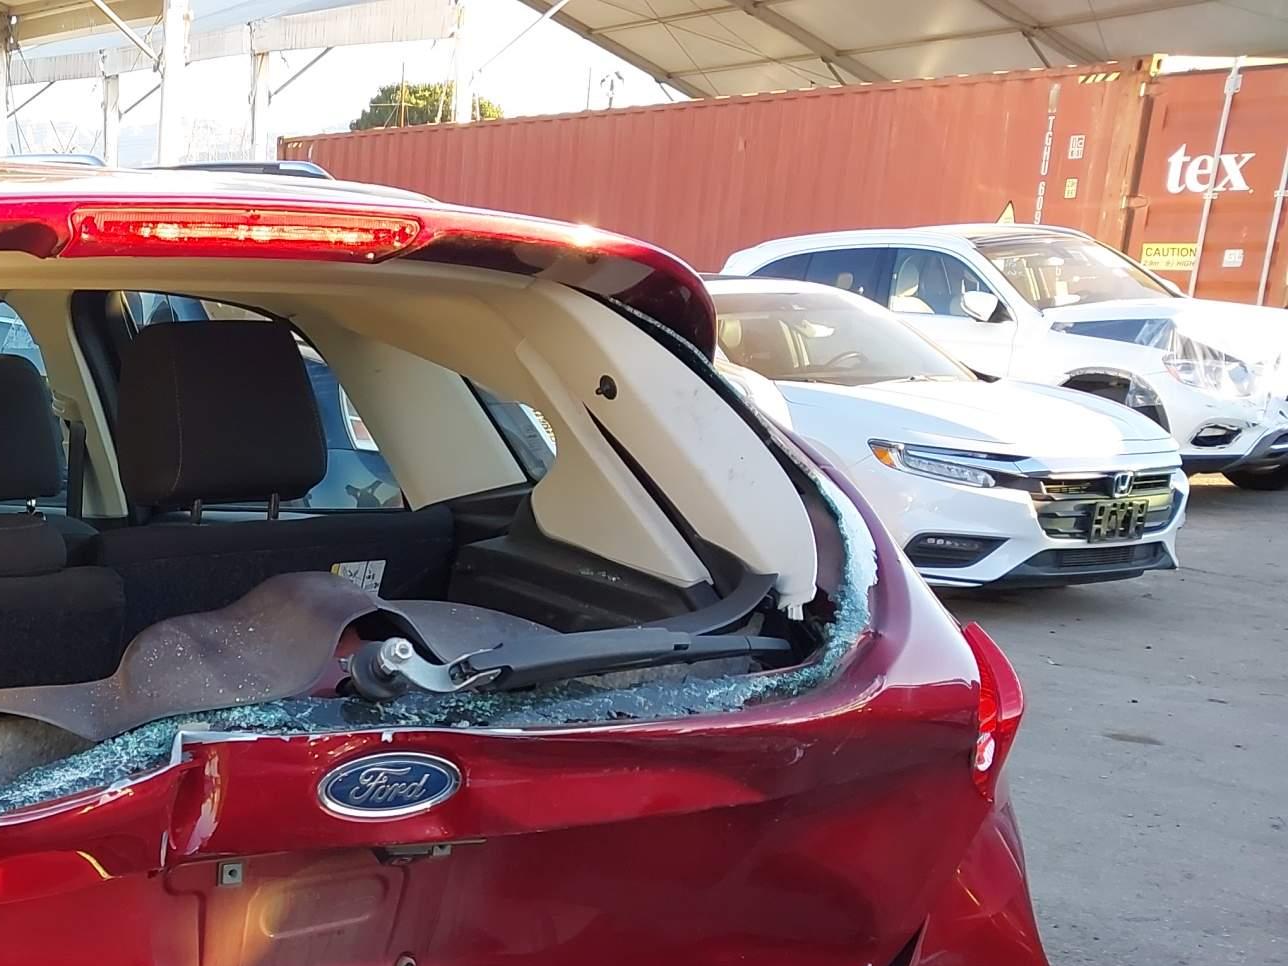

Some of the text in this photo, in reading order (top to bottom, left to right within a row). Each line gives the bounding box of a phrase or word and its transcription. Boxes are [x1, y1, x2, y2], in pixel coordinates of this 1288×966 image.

[1166, 143, 1256, 194] tex
[1145, 247, 1197, 257] CAUTION
[350, 766, 430, 802] Ford
